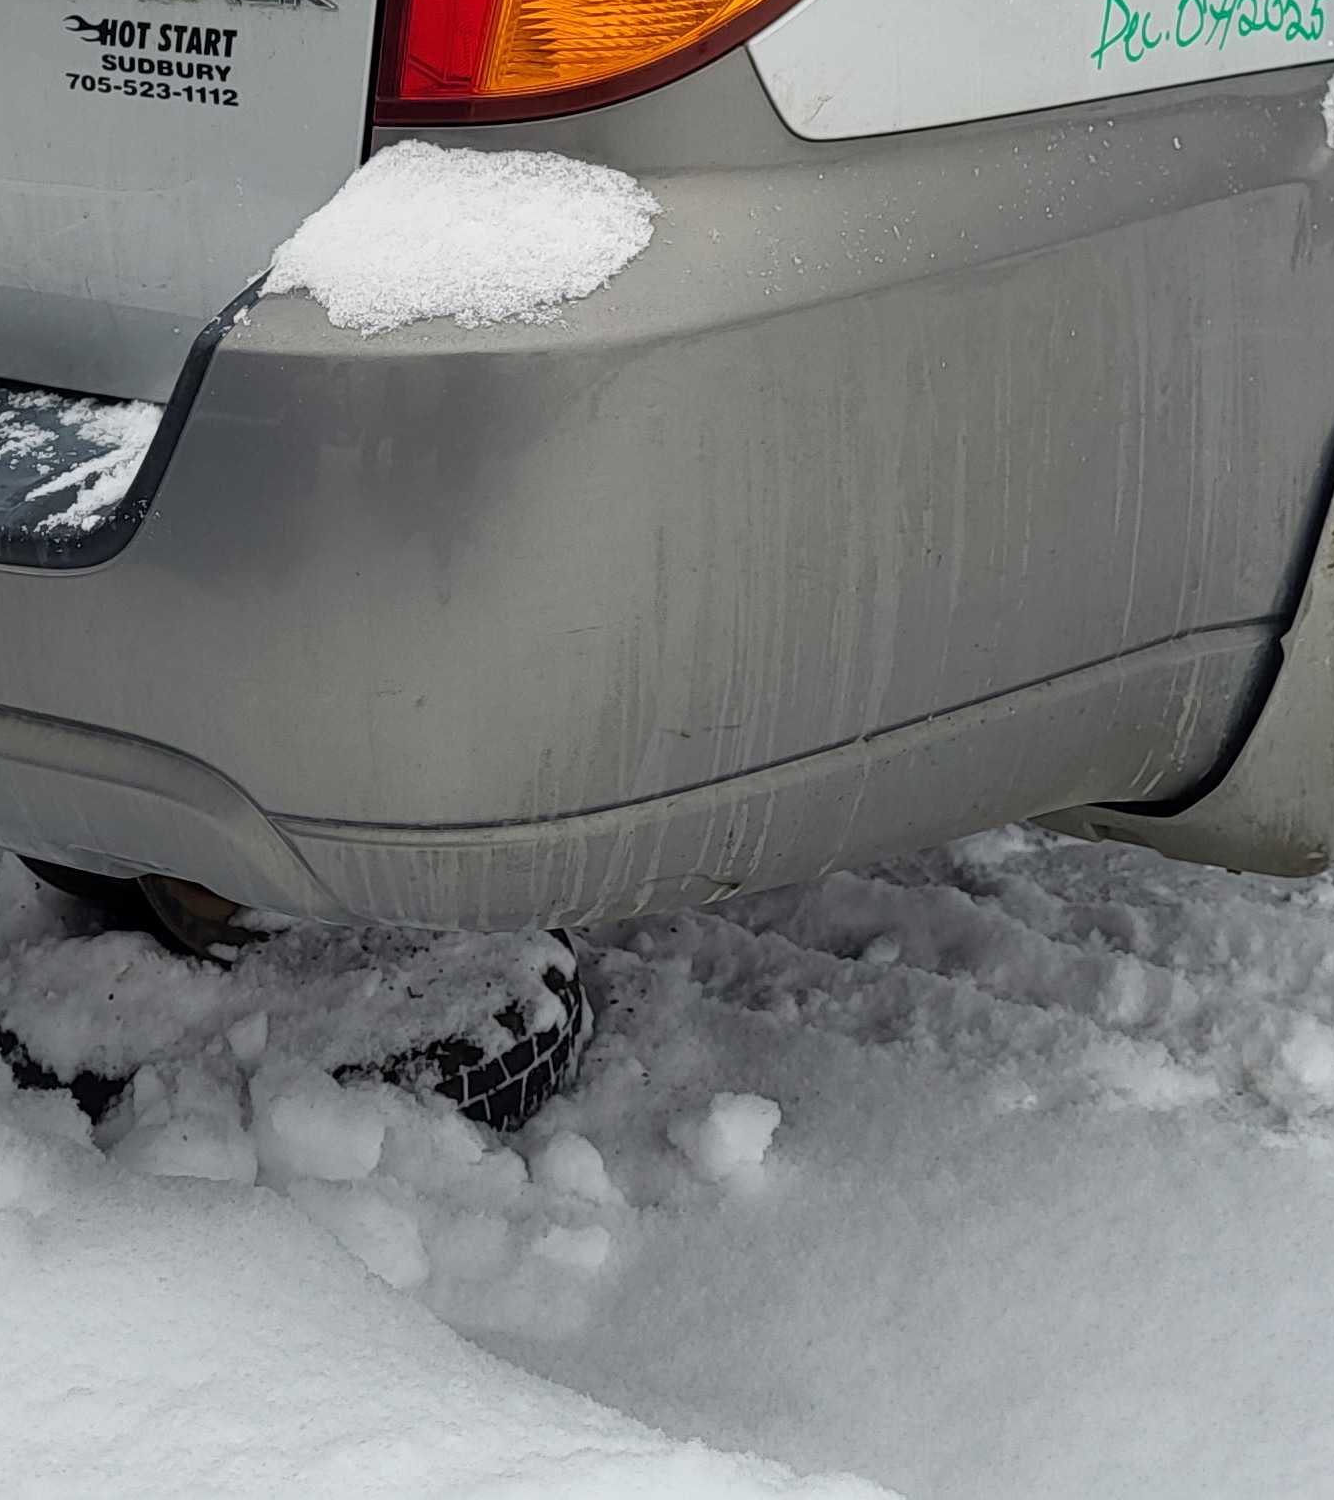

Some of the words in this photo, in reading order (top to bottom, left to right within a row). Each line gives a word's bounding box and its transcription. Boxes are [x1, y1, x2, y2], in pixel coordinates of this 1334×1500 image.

[99, 18, 151, 51] HOT
[157, 25, 239, 58] START
[101, 53, 232, 83] SUDBURY
[66, 73, 240, 107] 705-523-1112
